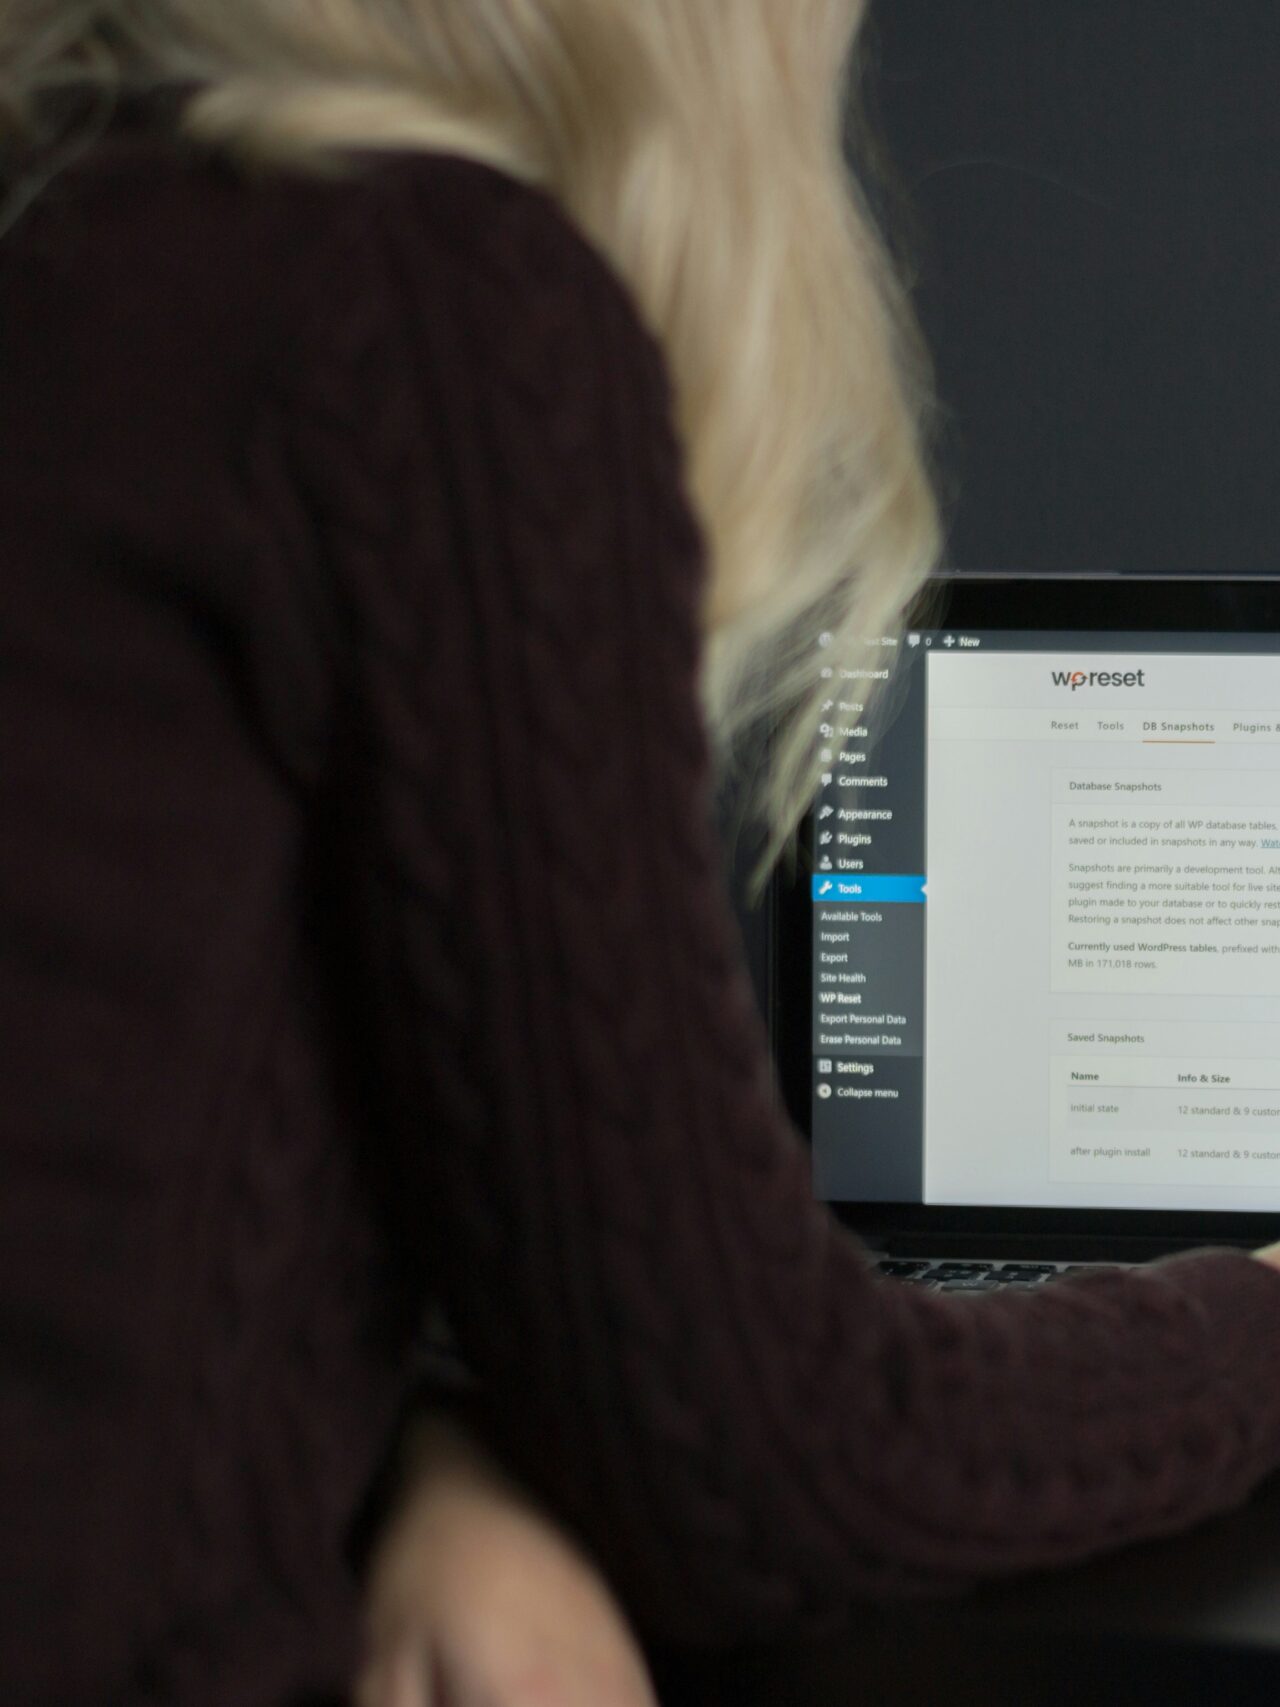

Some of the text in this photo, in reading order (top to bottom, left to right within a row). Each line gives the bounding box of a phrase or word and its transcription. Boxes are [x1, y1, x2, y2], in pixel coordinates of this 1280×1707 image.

[925, 637, 932, 647] 0
[959, 637, 980, 647] New
[839, 702, 864, 712] Posts
[1051, 720, 1079, 730] Reset
[1097, 721, 1124, 731] Tools
[1143, 721, 1215, 734] DB Snapshots
[1233, 722, 1271, 734] Plugins
[839, 726, 868, 737] Media
[840, 751, 866, 765] Pages
[838, 775, 888, 787] Comments
[1069, 781, 1162, 793] Database Snapshots
[838, 809, 892, 821] Appearance
[838, 833, 872, 847] Plugins
[1068, 836, 1095, 845] saved
[1109, 836, 1148, 846] included
[1150, 837, 1159, 846] in
[1161, 837, 1207, 848] snapshots
[1208, 838, 1217, 847] in
[1219, 839, 1236, 849] any
[1238, 840, 1258, 849] way.
[838, 858, 863, 870] Users
[1069, 863, 1115, 874] Snapshots
[1117, 865, 1132, 873] are
[1134, 864, 1174, 875] primarily
[1176, 866, 1181, 874] a
[1184, 864, 1243, 876] development
[1245, 866, 1265, 875] tool.
[838, 883, 862, 894] Tools
[821, 911, 882, 922] Available Tools
[1068, 914, 1111, 926] Restoring
[1121, 915, 1162, 927] snapshot
[1164, 916, 1186, 925] does
[1189, 917, 1204, 925] not
[1206, 916, 1232, 926] affect
[1234, 917, 1258, 926] other
[821, 932, 850, 944] Import
[1067, 941, 1111, 953] Currently
[1113, 942, 1135, 952] used
[1137, 942, 1187, 953] WordPress
[1189, 943, 1219, 953] tables,
[1222, 944, 1258, 955] prefixed
[1261, 945, 1280, 954] with
[821, 952, 848, 964] Export
[1067, 958, 1083, 968] MB
[1085, 959, 1094, 968] in
[1134, 961, 1157, 969] rows.
[821, 973, 866, 983] Site Health
[819, 992, 861, 1004] WP Reset
[820, 1013, 906, 1026] Export Personal Data
[820, 1034, 901, 1045] Erase Personal Data
[1067, 1033, 1145, 1045] Saved Snapshots
[837, 1061, 874, 1076] Settings
[1071, 1072, 1099, 1081] Name
[1178, 1074, 1231, 1083] Info & Size
[837, 1087, 899, 1099] Collapse menu
[1070, 1103, 1119, 1113] initial state
[1178, 1105, 1188, 1115] 12
[1191, 1106, 1230, 1116] standard
[1233, 1106, 1241, 1116] &
[1243, 1106, 1250, 1116] 9
[1070, 1146, 1150, 1159] after plugin install
[1178, 1149, 1188, 1158] 12
[1190, 1149, 1230, 1159] standard
[1232, 1150, 1242, 1159] &
[1243, 1150, 1250, 1159] 9
